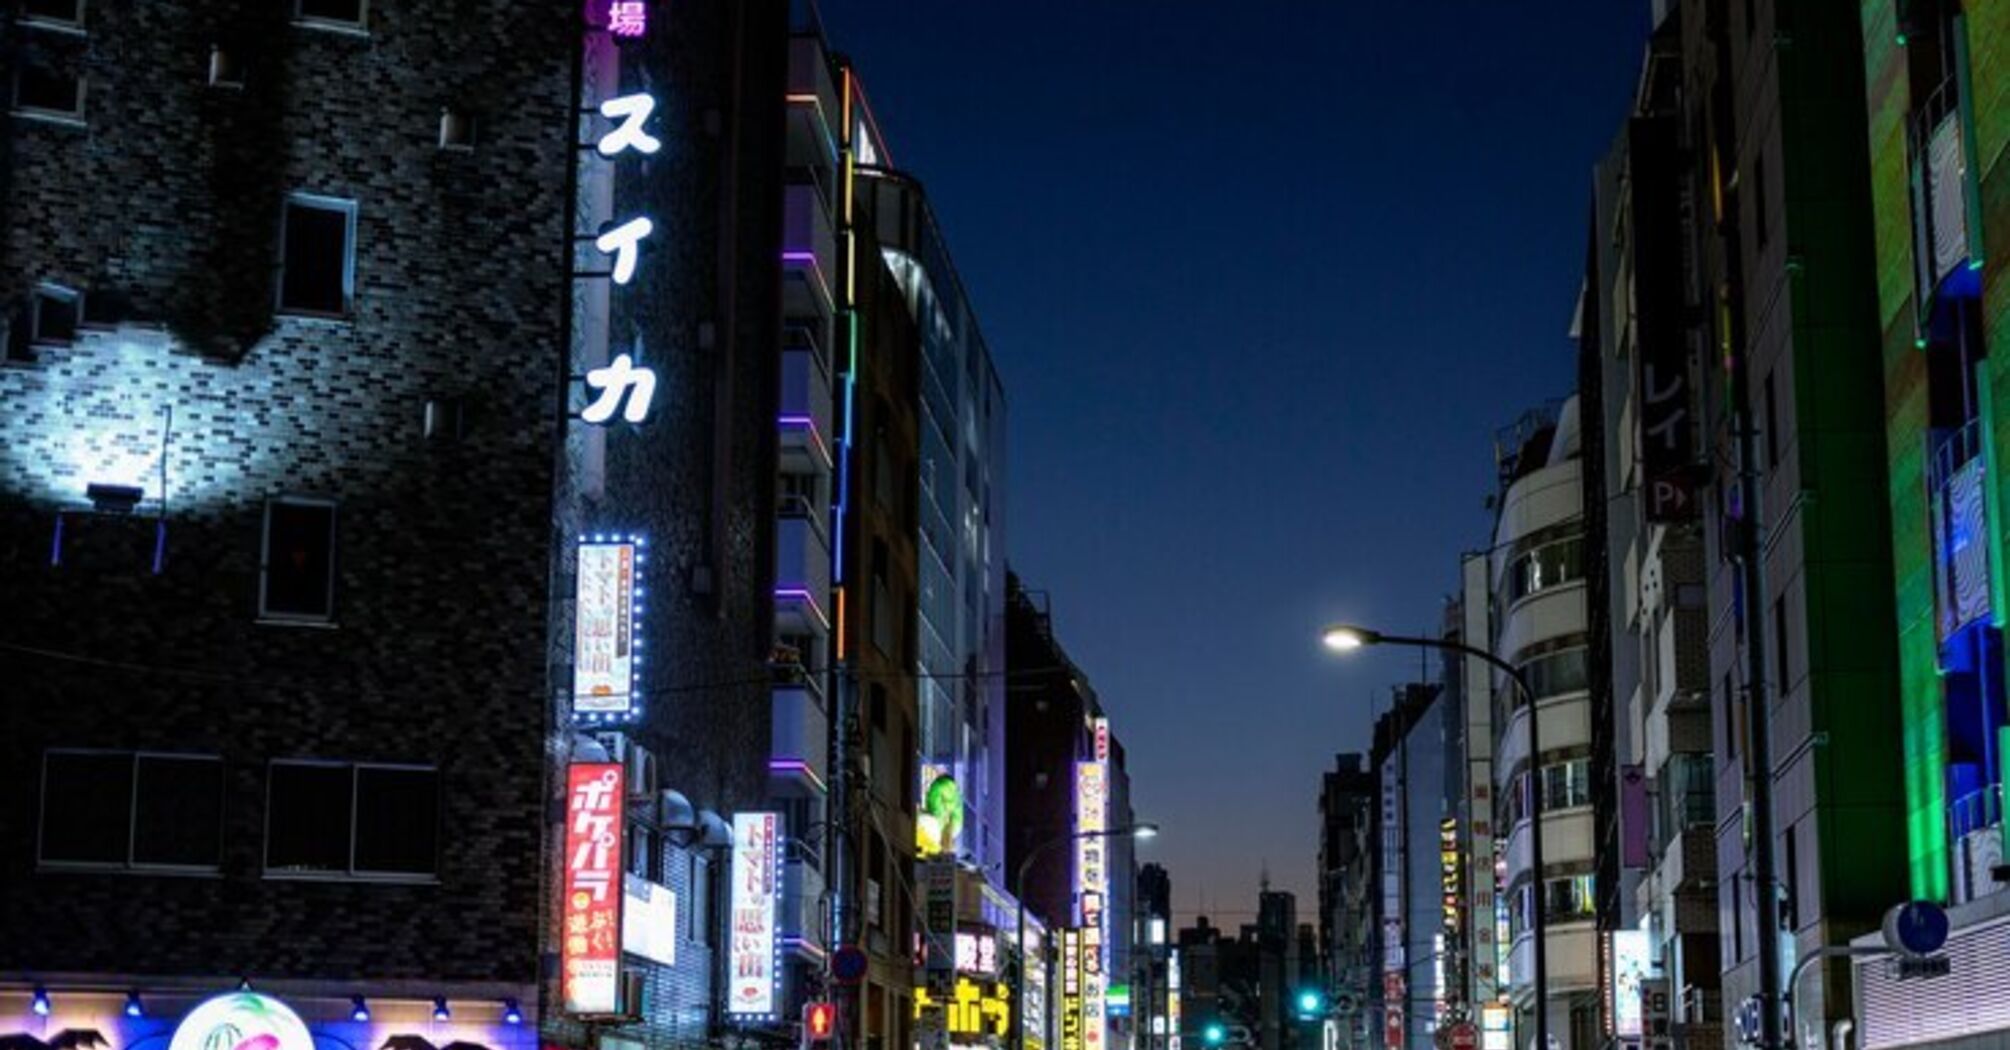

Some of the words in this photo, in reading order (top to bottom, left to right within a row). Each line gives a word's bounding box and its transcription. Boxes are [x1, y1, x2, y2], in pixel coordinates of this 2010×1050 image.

[608, 1, 644, 36] 場
[581, 92, 661, 424] スイカ
[571, 768, 618, 901] ポケパラ
